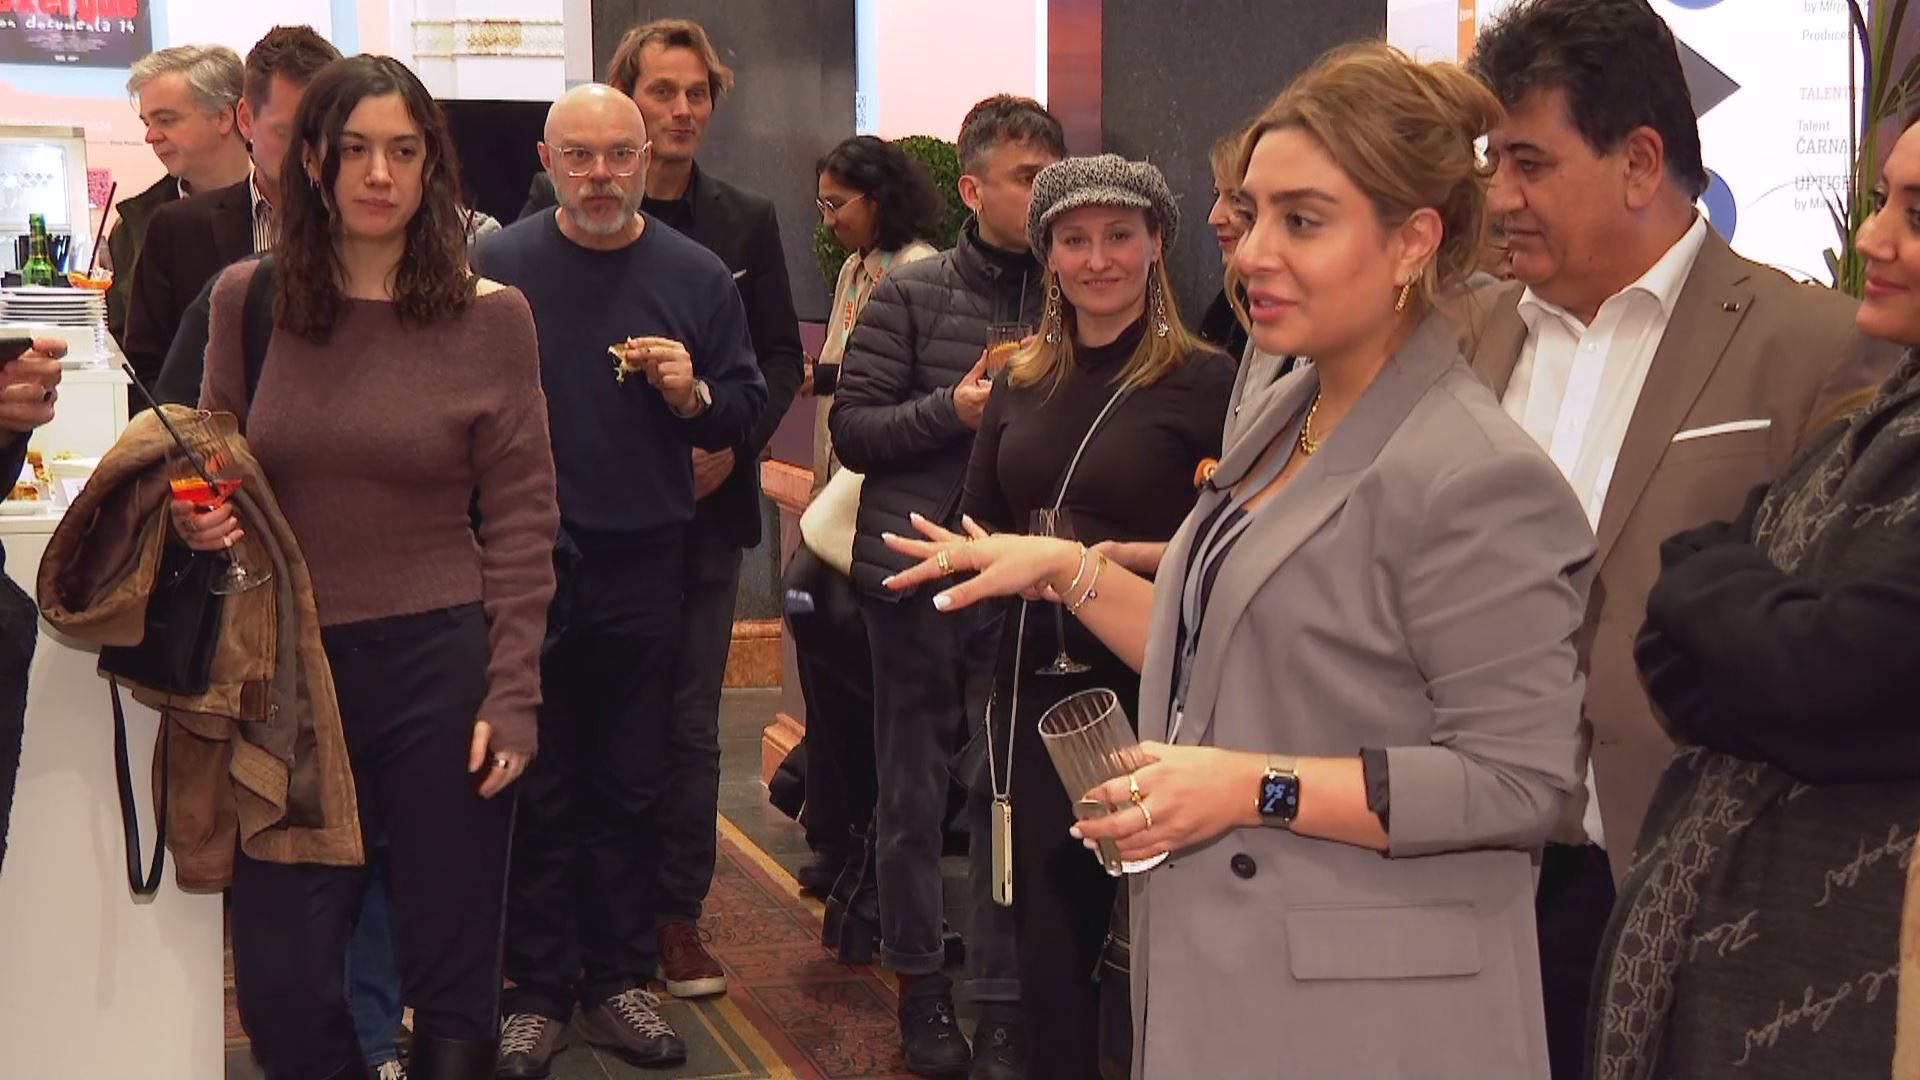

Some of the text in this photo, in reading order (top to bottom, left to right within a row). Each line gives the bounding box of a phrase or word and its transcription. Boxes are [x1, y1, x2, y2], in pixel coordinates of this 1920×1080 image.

[118, 19, 135, 34] 14
[1802, 28, 1852, 40] Produce
[1797, 119, 1830, 132] Talent
